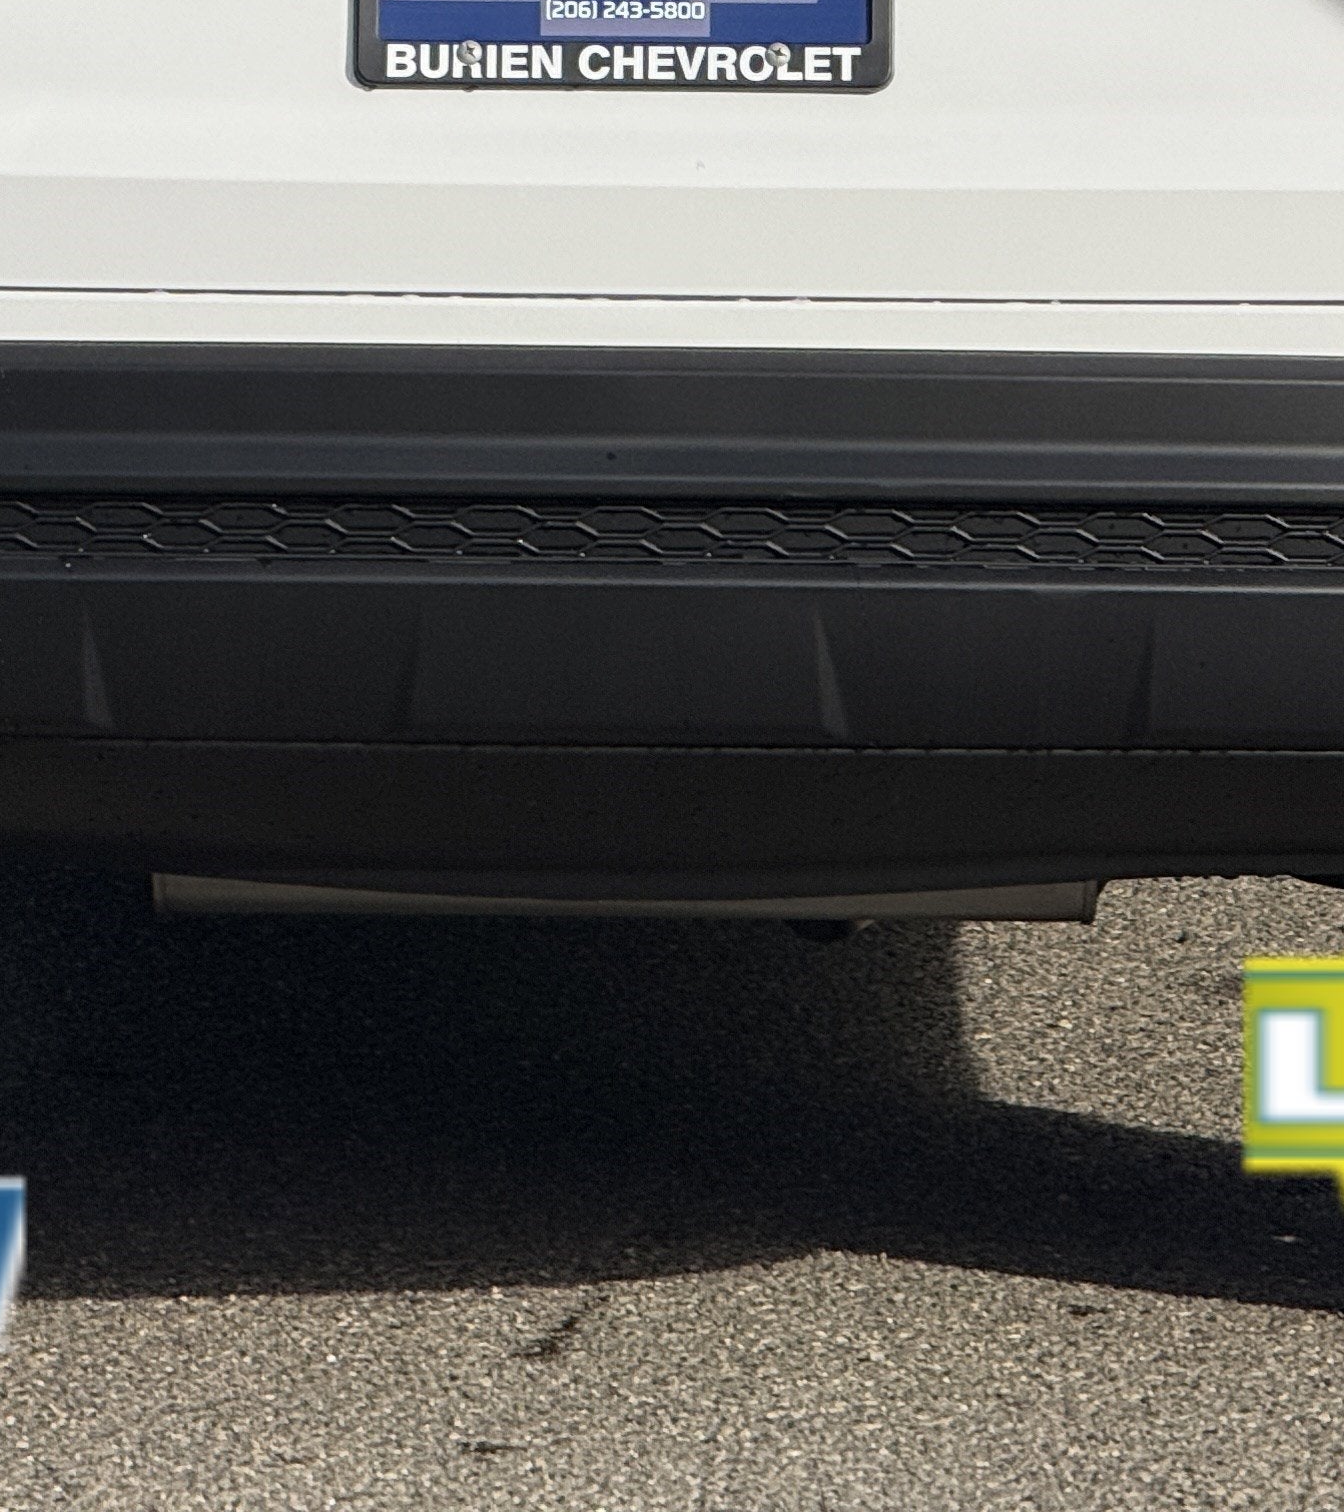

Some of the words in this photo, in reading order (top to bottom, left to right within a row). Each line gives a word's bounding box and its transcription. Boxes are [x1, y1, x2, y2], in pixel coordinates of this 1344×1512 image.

[545, 0, 598, 20] (206)
[603, 1, 705, 20] 243-5800
[386, 43, 563, 79] BURIEN
[578, 44, 862, 82] CHEVROLET
